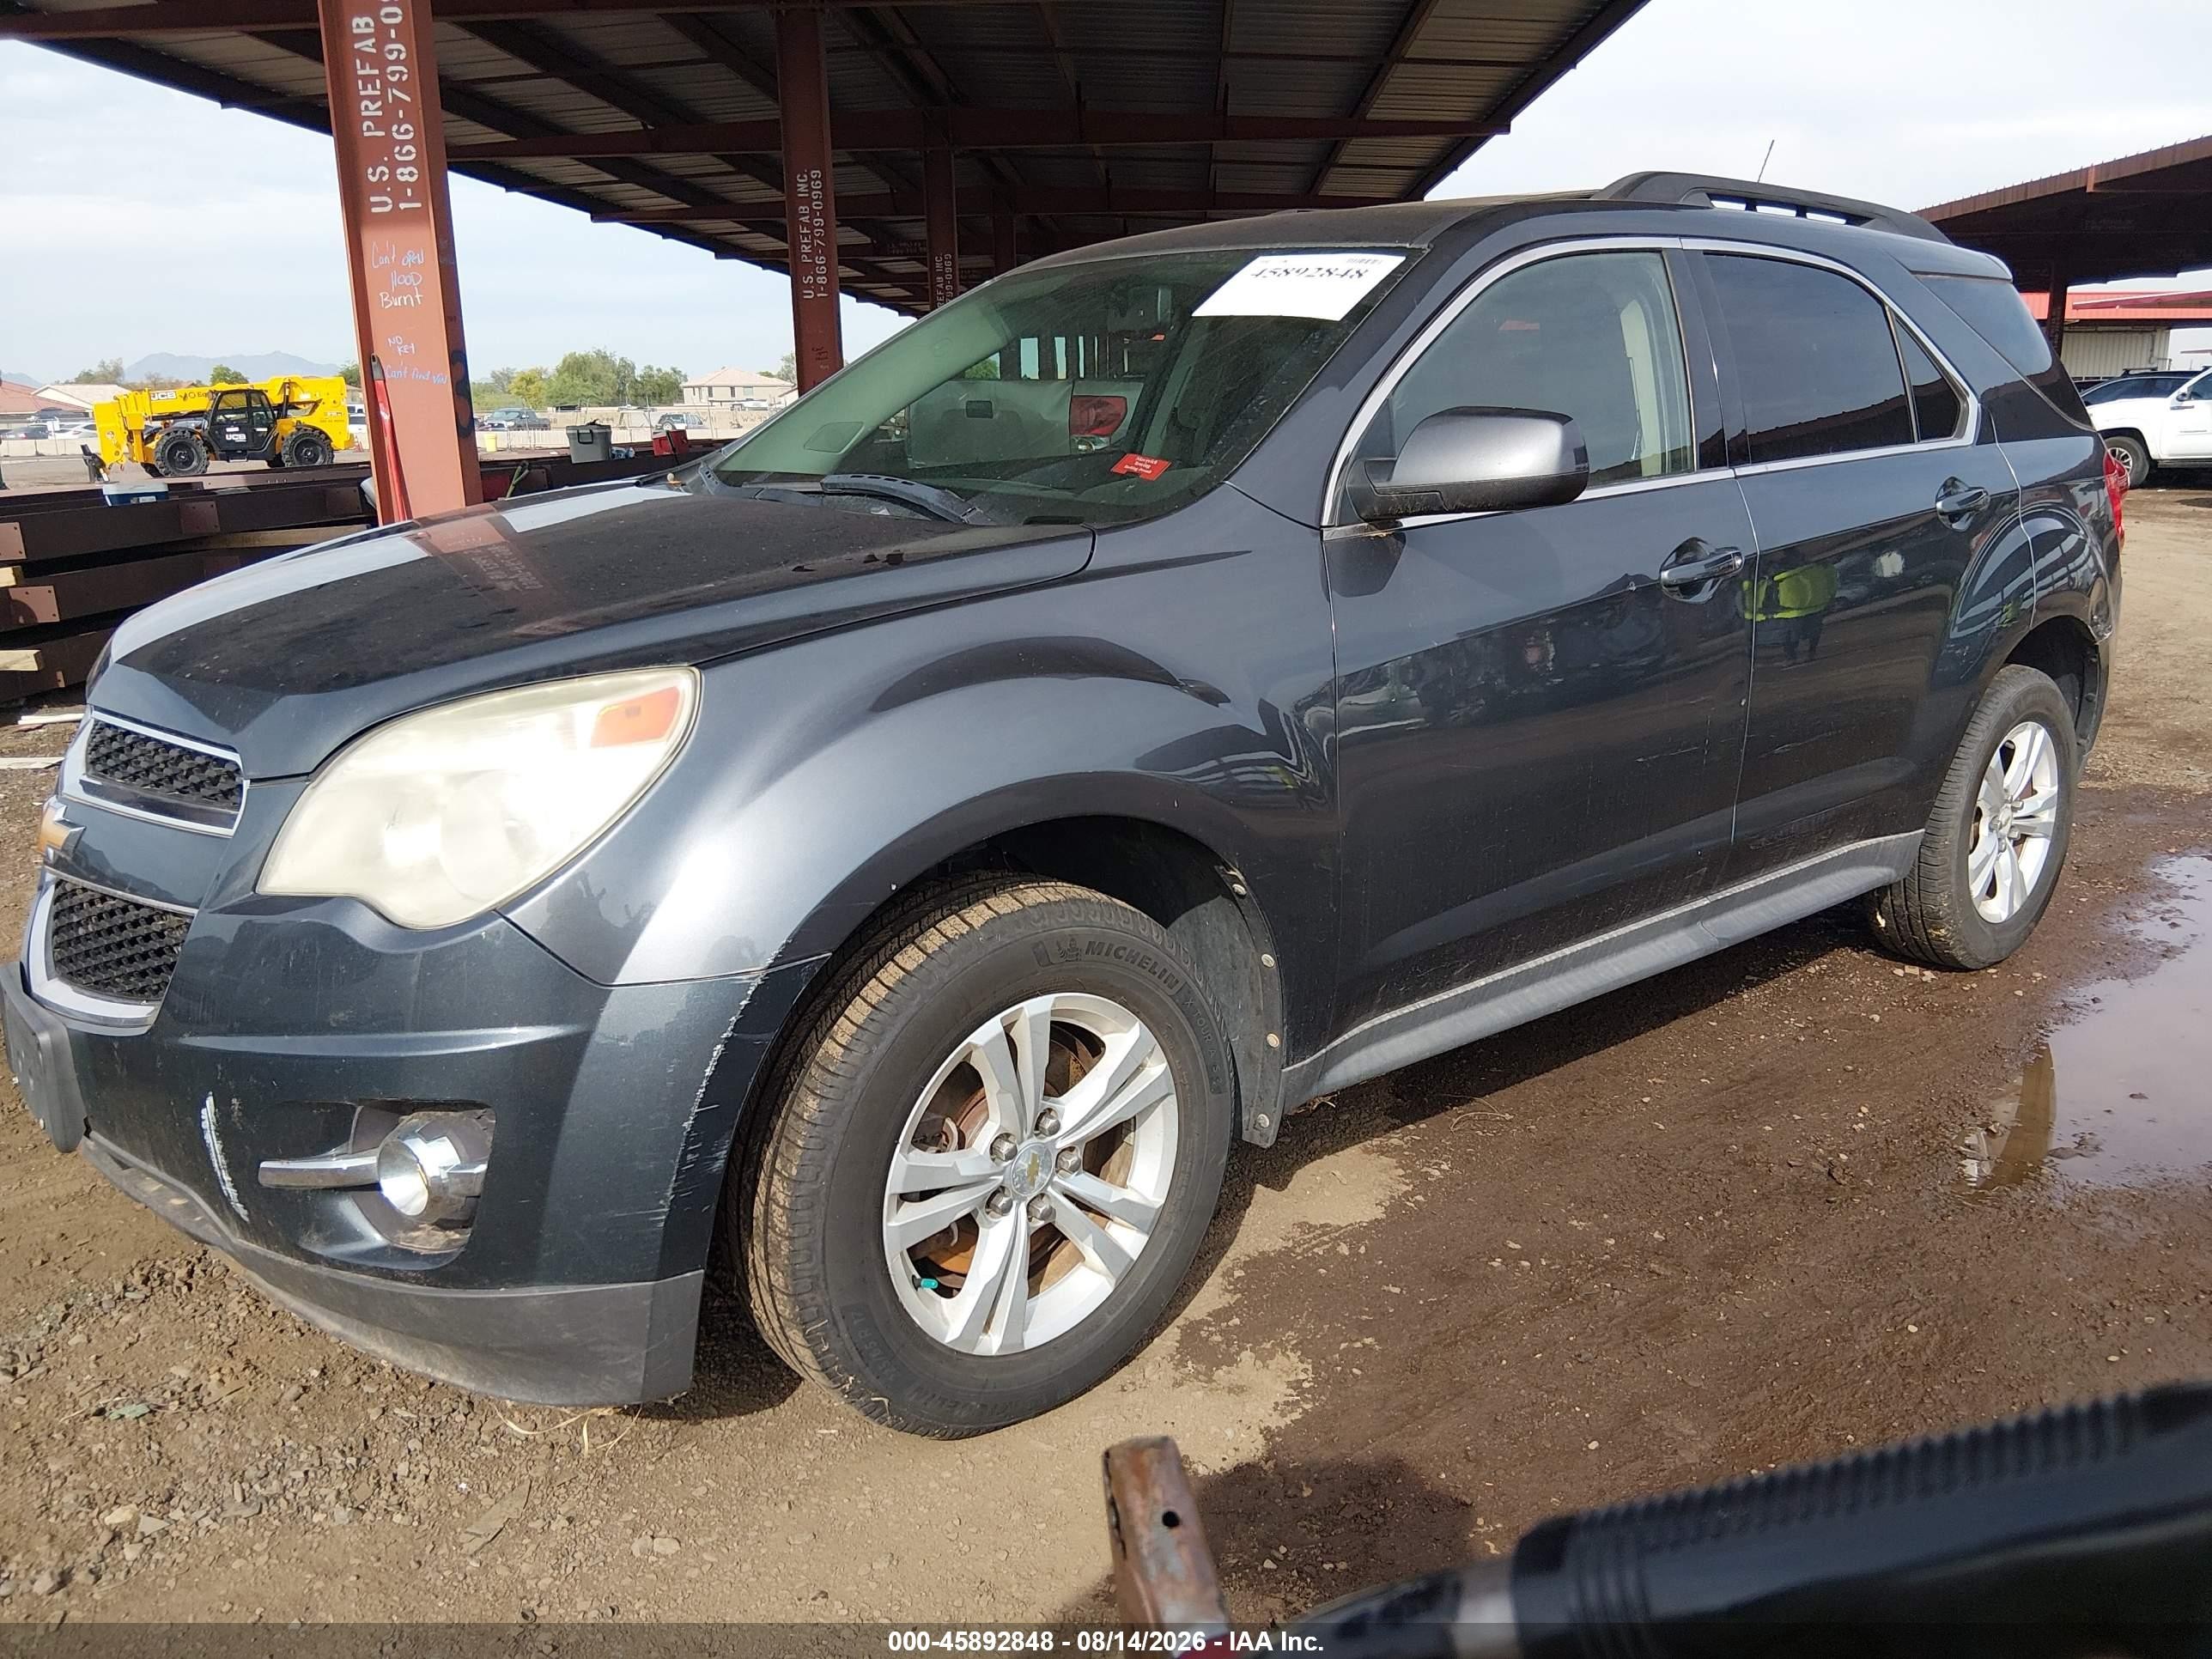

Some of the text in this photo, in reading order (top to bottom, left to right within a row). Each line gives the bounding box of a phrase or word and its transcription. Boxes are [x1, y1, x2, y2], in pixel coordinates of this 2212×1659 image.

[351, 16, 393, 213] U.S. PREFAB
[380, 0, 422, 210] 1-866-799-0
[796, 169, 815, 299] U.S. PREFAB INC.
[811, 170, 829, 297] 1-866-799-0969
[380, 287, 423, 309] Burnt
[150, 392, 176, 400] JCB
[1085, 940, 1180, 990] MICHELIN
